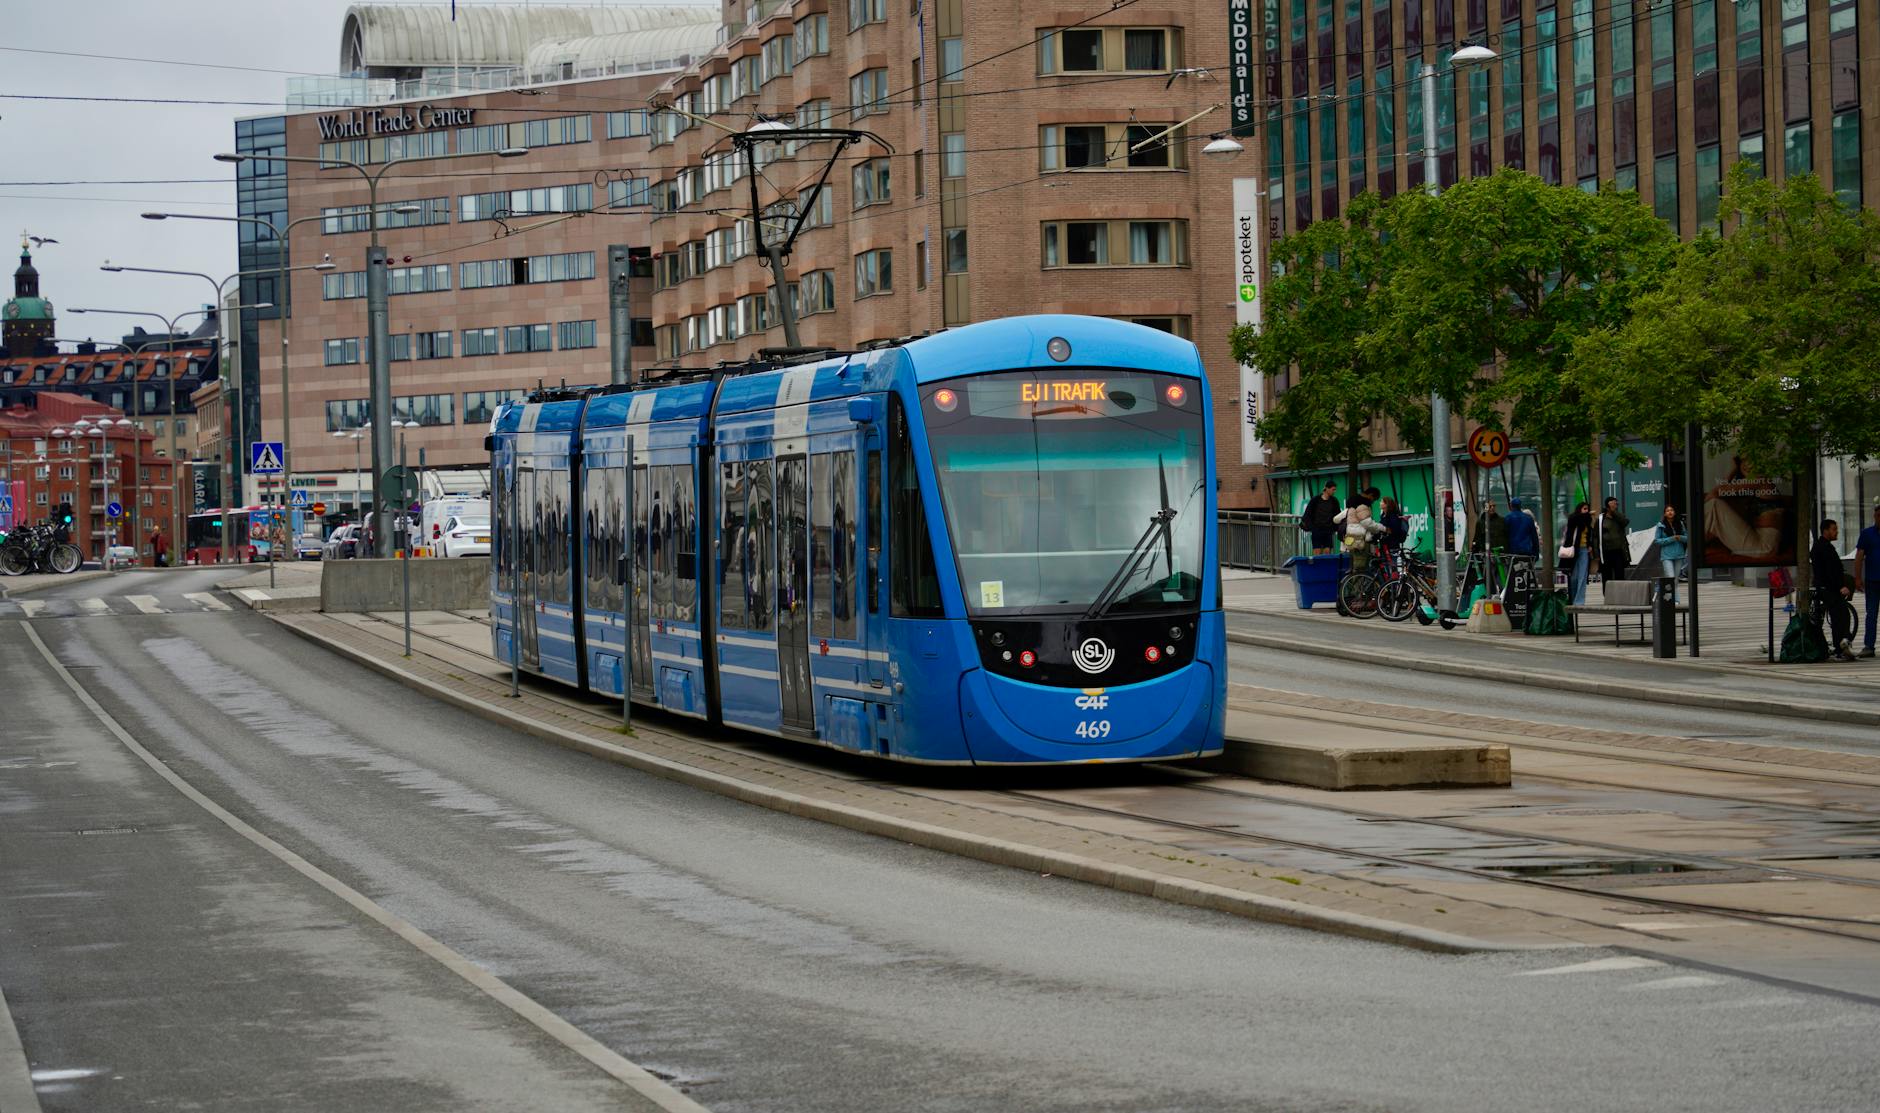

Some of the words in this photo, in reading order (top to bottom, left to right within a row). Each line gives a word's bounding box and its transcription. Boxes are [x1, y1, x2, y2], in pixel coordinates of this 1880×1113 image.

[1231, 0, 1250, 121] McDonald's
[316, 110, 368, 140] World
[368, 103, 415, 134] Trade
[416, 104, 476, 130] Center
[1239, 215, 1255, 284] apoteket
[1022, 383, 1041, 402] EJ
[1044, 383, 1049, 401] I
[1052, 381, 1106, 401] TRAFIK
[1246, 390, 1257, 425] Hertz
[1474, 435, 1504, 457] 40
[194, 469, 206, 505] KLARA
[1718, 488, 1737, 497] look
[1738, 487, 1754, 496] this
[984, 592, 1000, 603] 13
[1083, 644, 1104, 659] SL
[1074, 695, 1110, 711] CAF
[1075, 720, 1112, 739] 469
